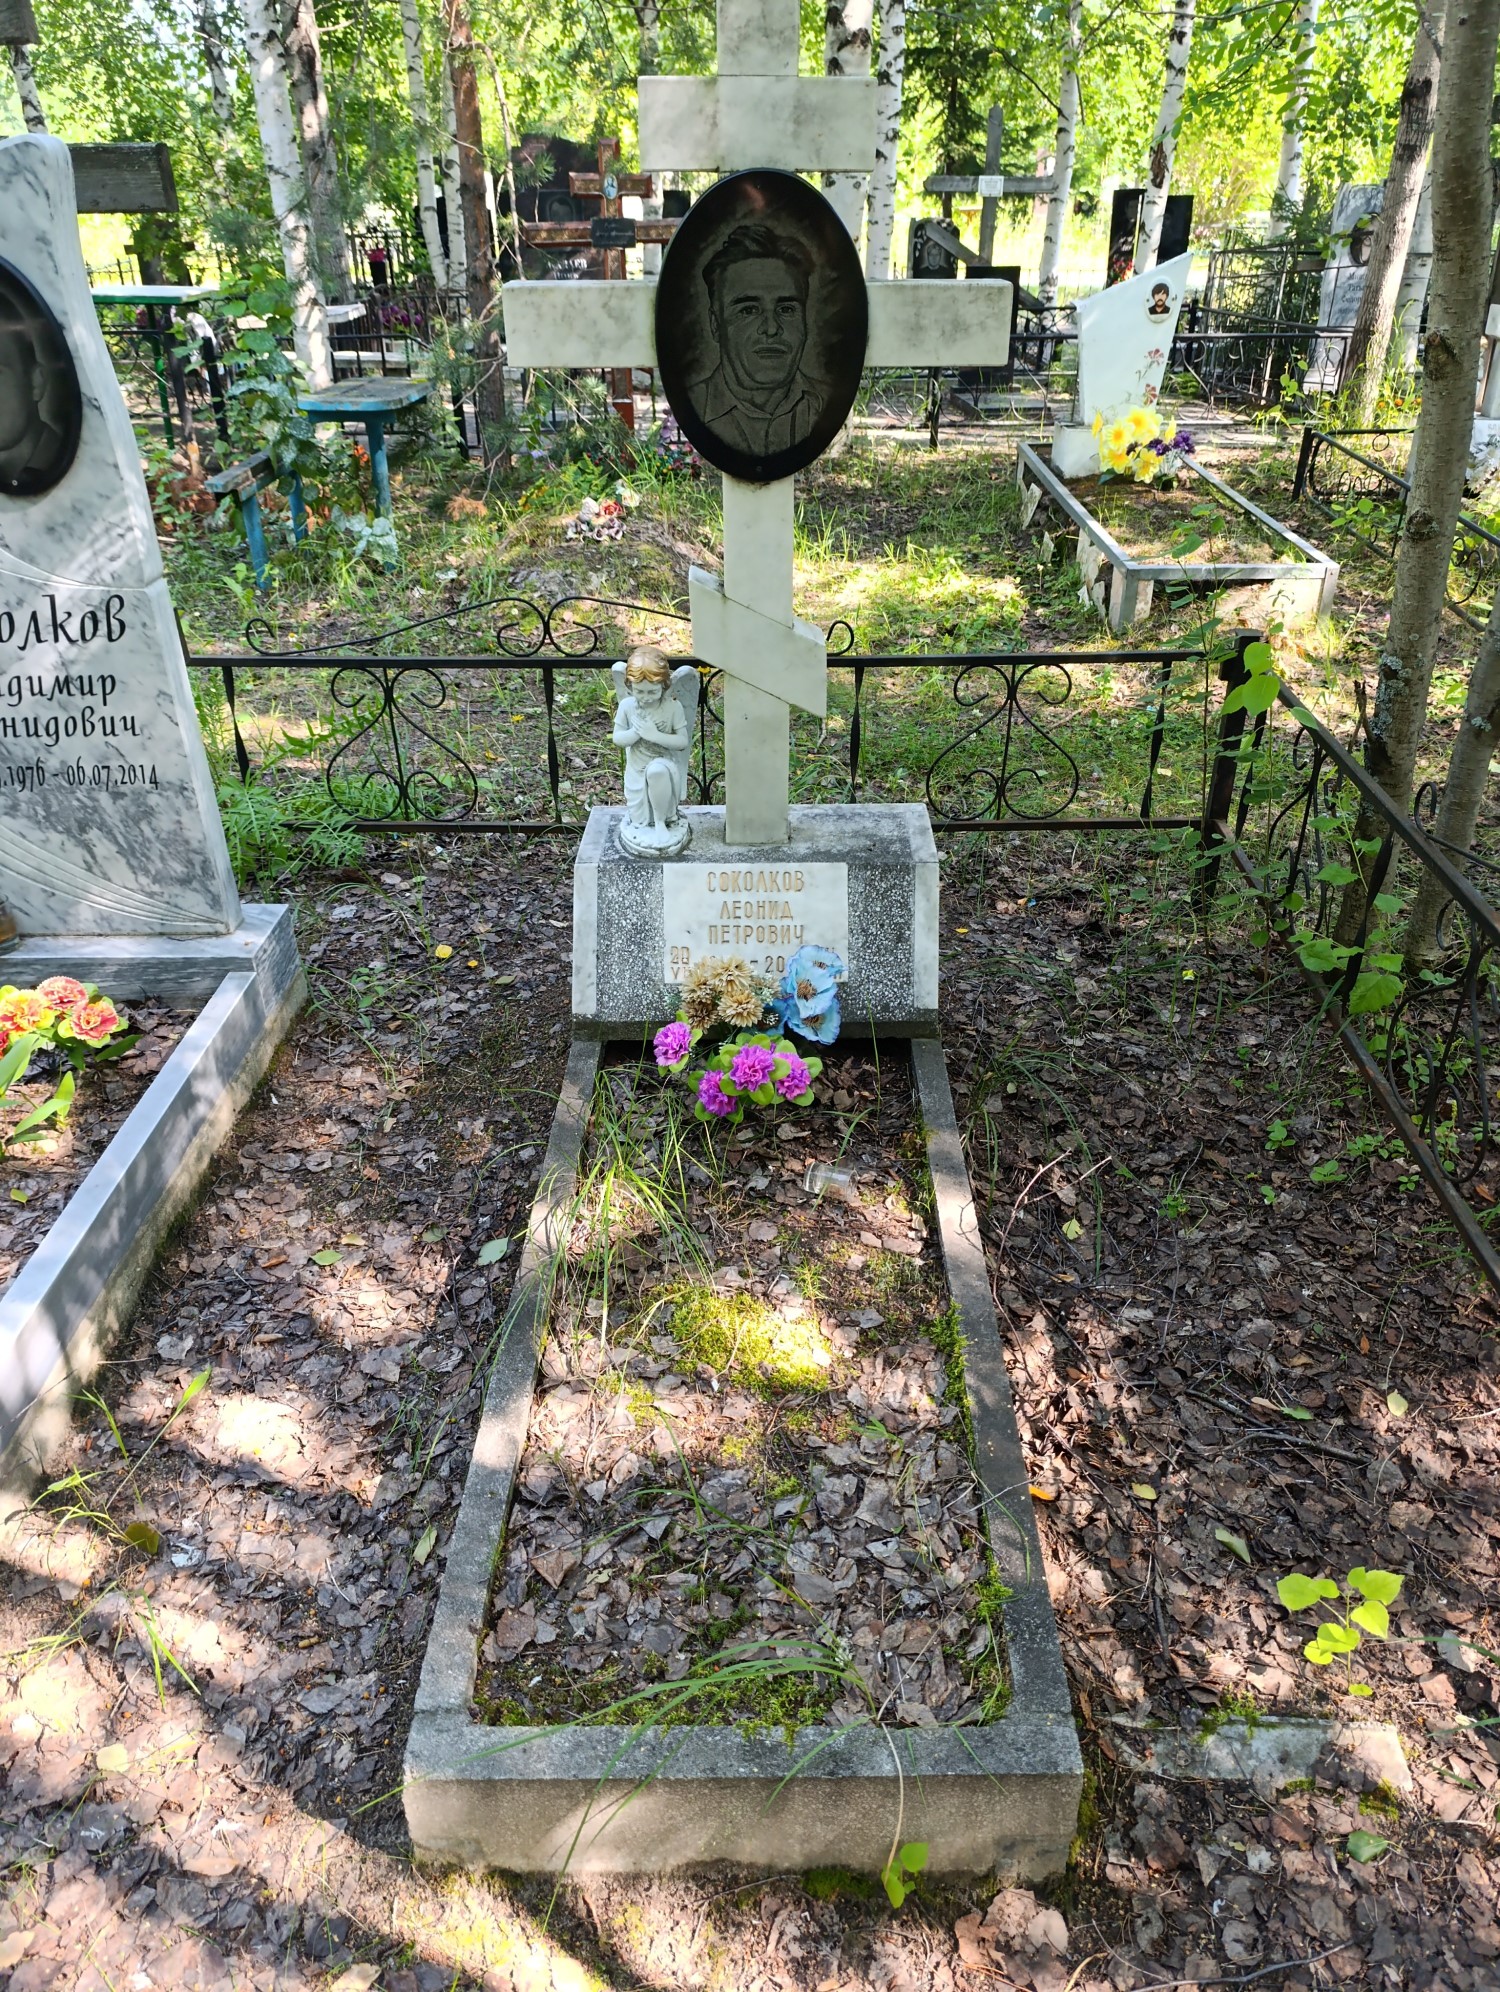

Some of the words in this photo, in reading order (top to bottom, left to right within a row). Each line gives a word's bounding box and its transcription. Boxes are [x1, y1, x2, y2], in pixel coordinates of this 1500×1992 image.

[0, 673, 117, 707] димир
[0, 706, 140, 747] нидович
[0, 755, 45, 793] .1976
[67, 755, 159, 792] 06.07.2014
[707, 870, 805, 893] СОКОЛКОВ
[720, 900, 794, 921] ЛЕОНИД
[708, 924, 804, 944] ПЕТРОВИЧ
